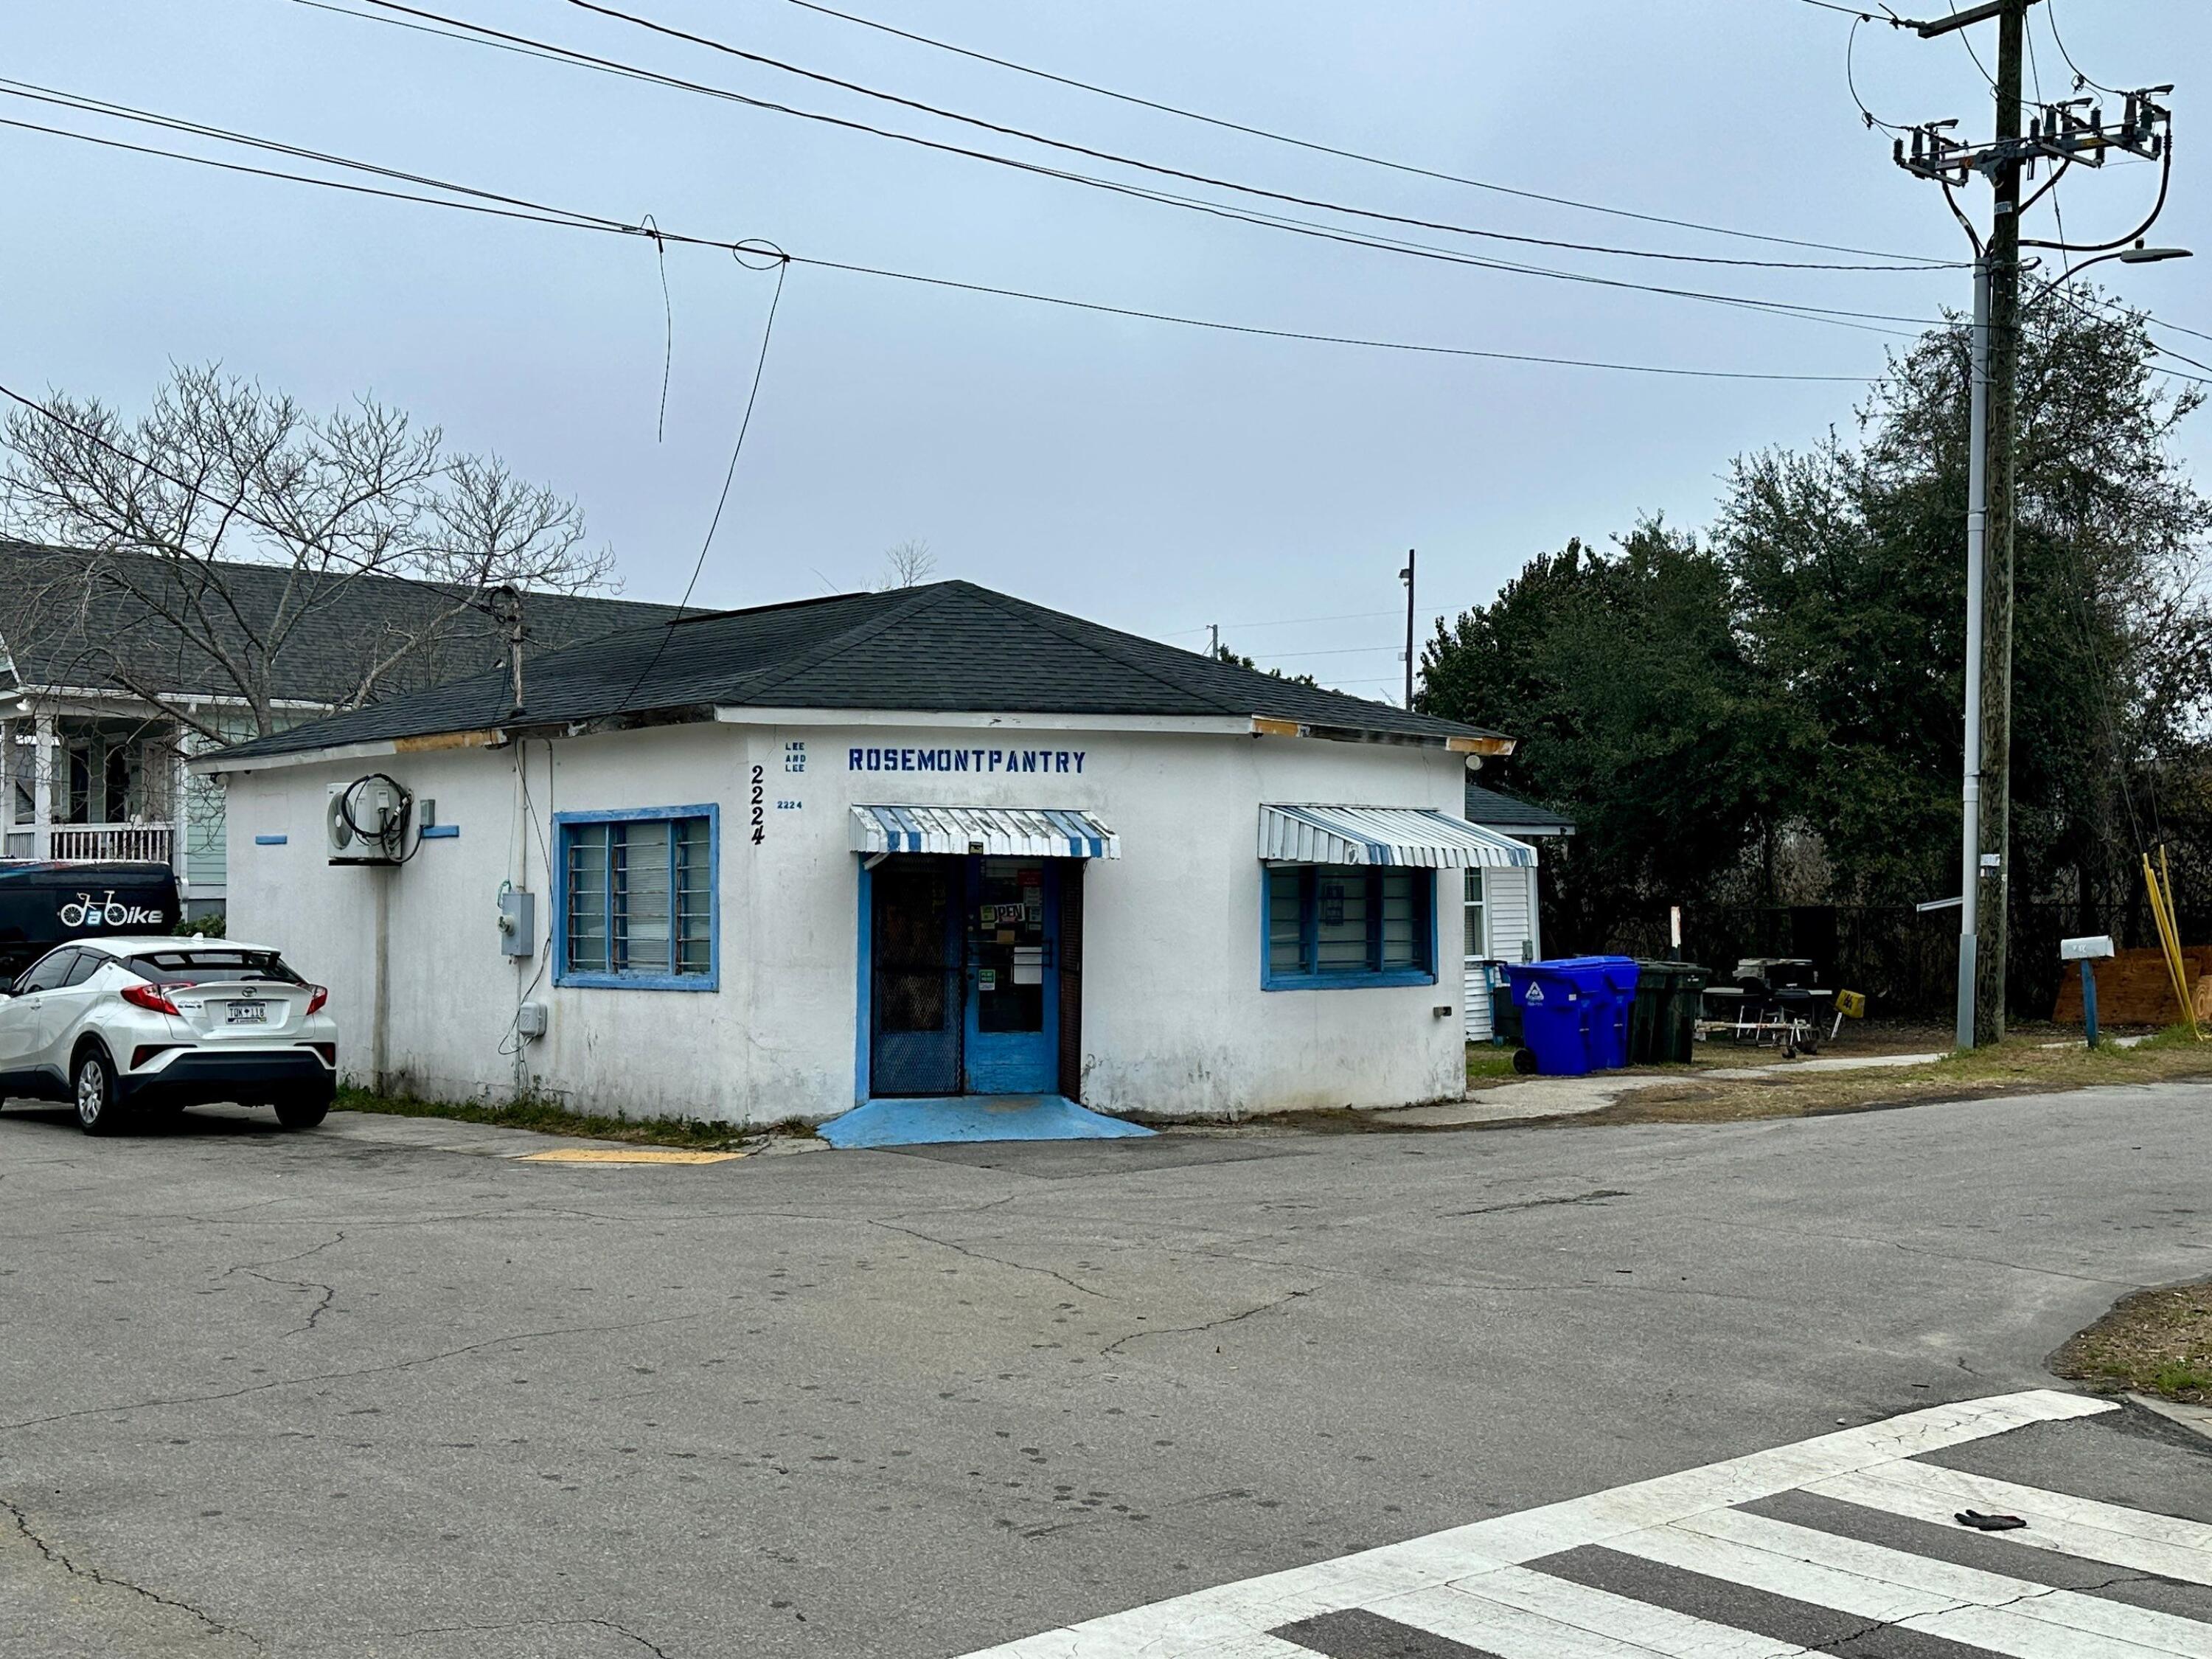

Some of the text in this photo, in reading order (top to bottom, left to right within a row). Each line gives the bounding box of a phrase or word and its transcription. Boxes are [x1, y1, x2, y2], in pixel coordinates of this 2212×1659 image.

[785, 742, 805, 751] LEE
[785, 754, 807, 762] AND
[785, 764, 805, 772] LEE
[777, 801, 802, 810] 2224
[993, 905, 1023, 922] PEN
